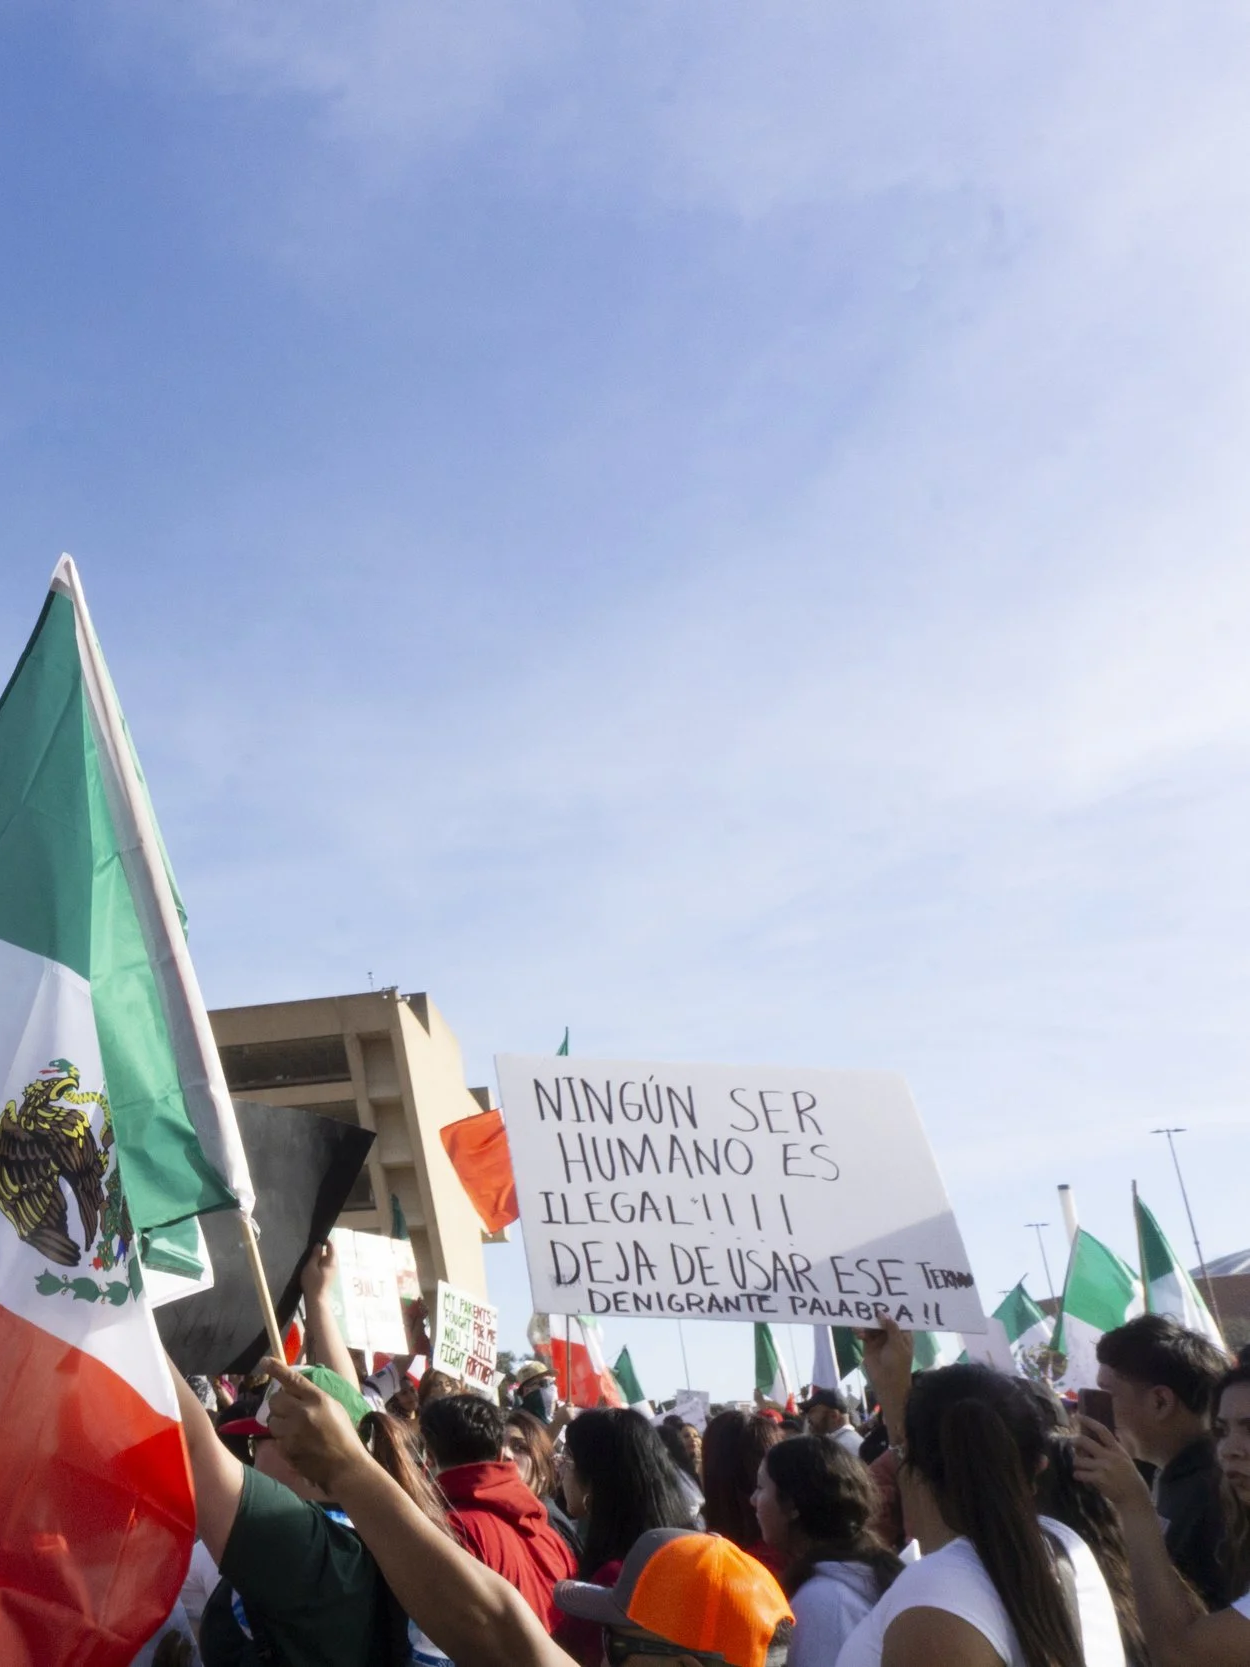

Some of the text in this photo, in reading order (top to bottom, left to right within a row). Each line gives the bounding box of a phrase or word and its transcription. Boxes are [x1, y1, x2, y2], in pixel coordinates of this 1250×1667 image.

[533, 1075, 823, 1135] NINGÚN SER
[557, 1132, 840, 1184] HUMANO ES
[549, 1240, 657, 1287] DEJA
[670, 1242, 720, 1287] DE
[726, 1247, 820, 1293] USAR
[833, 1255, 909, 1298] ESE
[588, 1288, 778, 1314] DENIGRANTE
[440, 1343, 465, 1369] FIGHT
